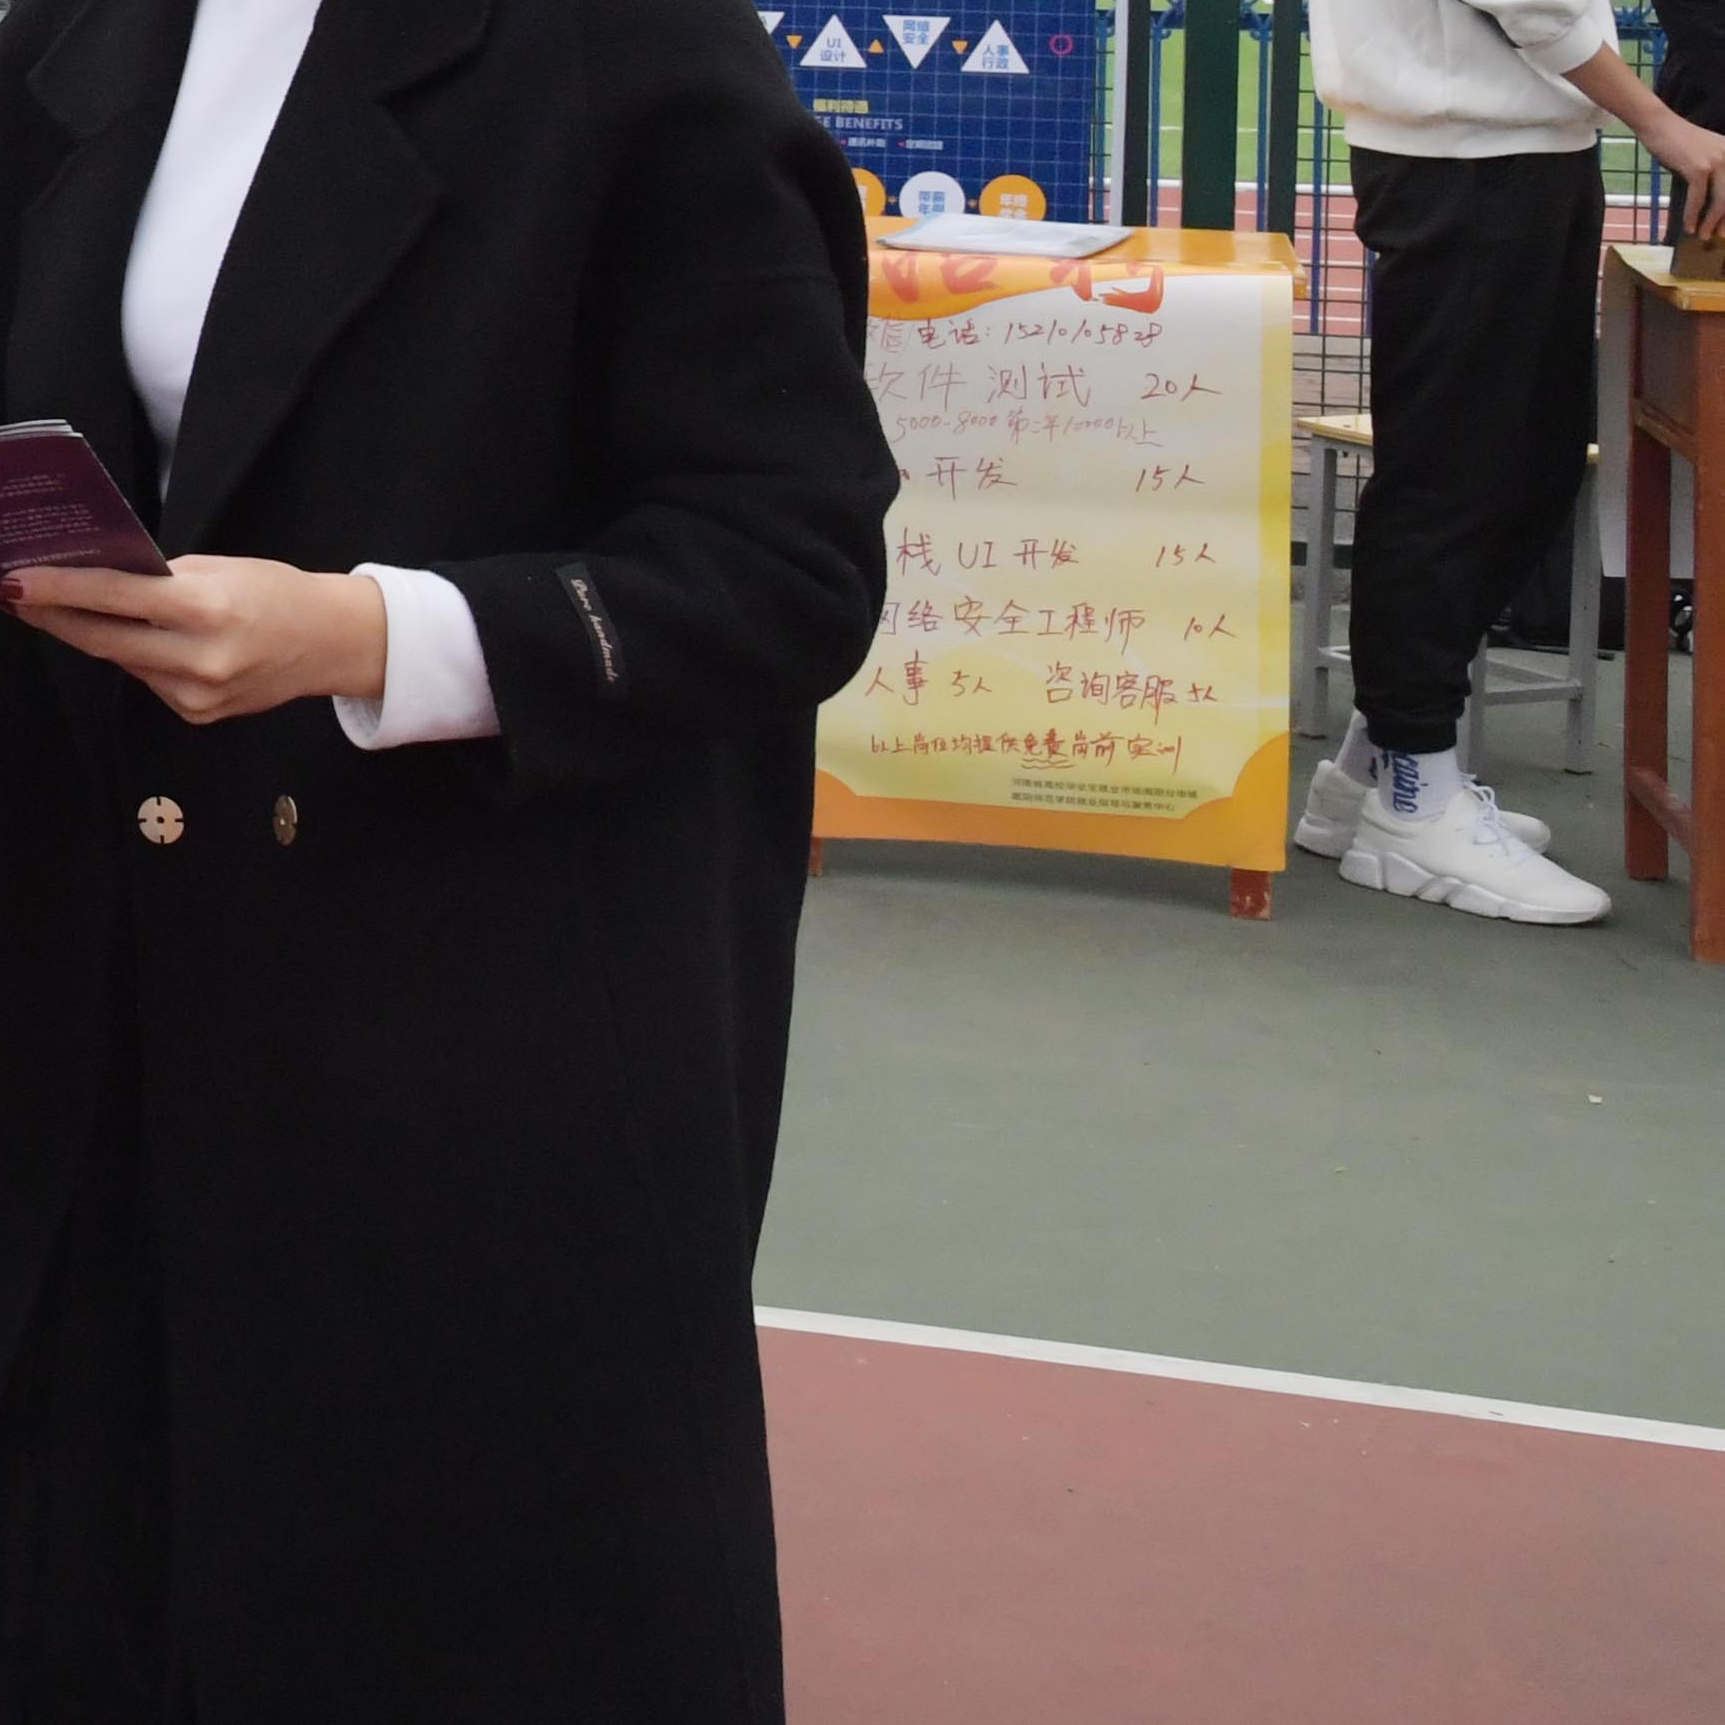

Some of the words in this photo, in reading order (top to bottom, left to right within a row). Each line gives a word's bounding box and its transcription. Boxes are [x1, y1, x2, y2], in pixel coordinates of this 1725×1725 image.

[903, 33, 929, 45] 安全
[982, 44, 1009, 56] 人事
[820, 49, 847, 62] 设计
[835, 117, 903, 130] BENEFITS
[987, 361, 1092, 408] 测试
[1141, 373, 1222, 401] 20人
[1135, 464, 1205, 493] 15人
[958, 541, 998, 568] UI
[1013, 539, 1080, 570] 开发
[1155, 543, 1216, 568] 15人
[881, 595, 1146, 655] 网络安全工程师
[1183, 614, 1236, 641] 10人
[865, 650, 929, 705] 人事
[1046, 661, 1180, 725] 咨询客服
